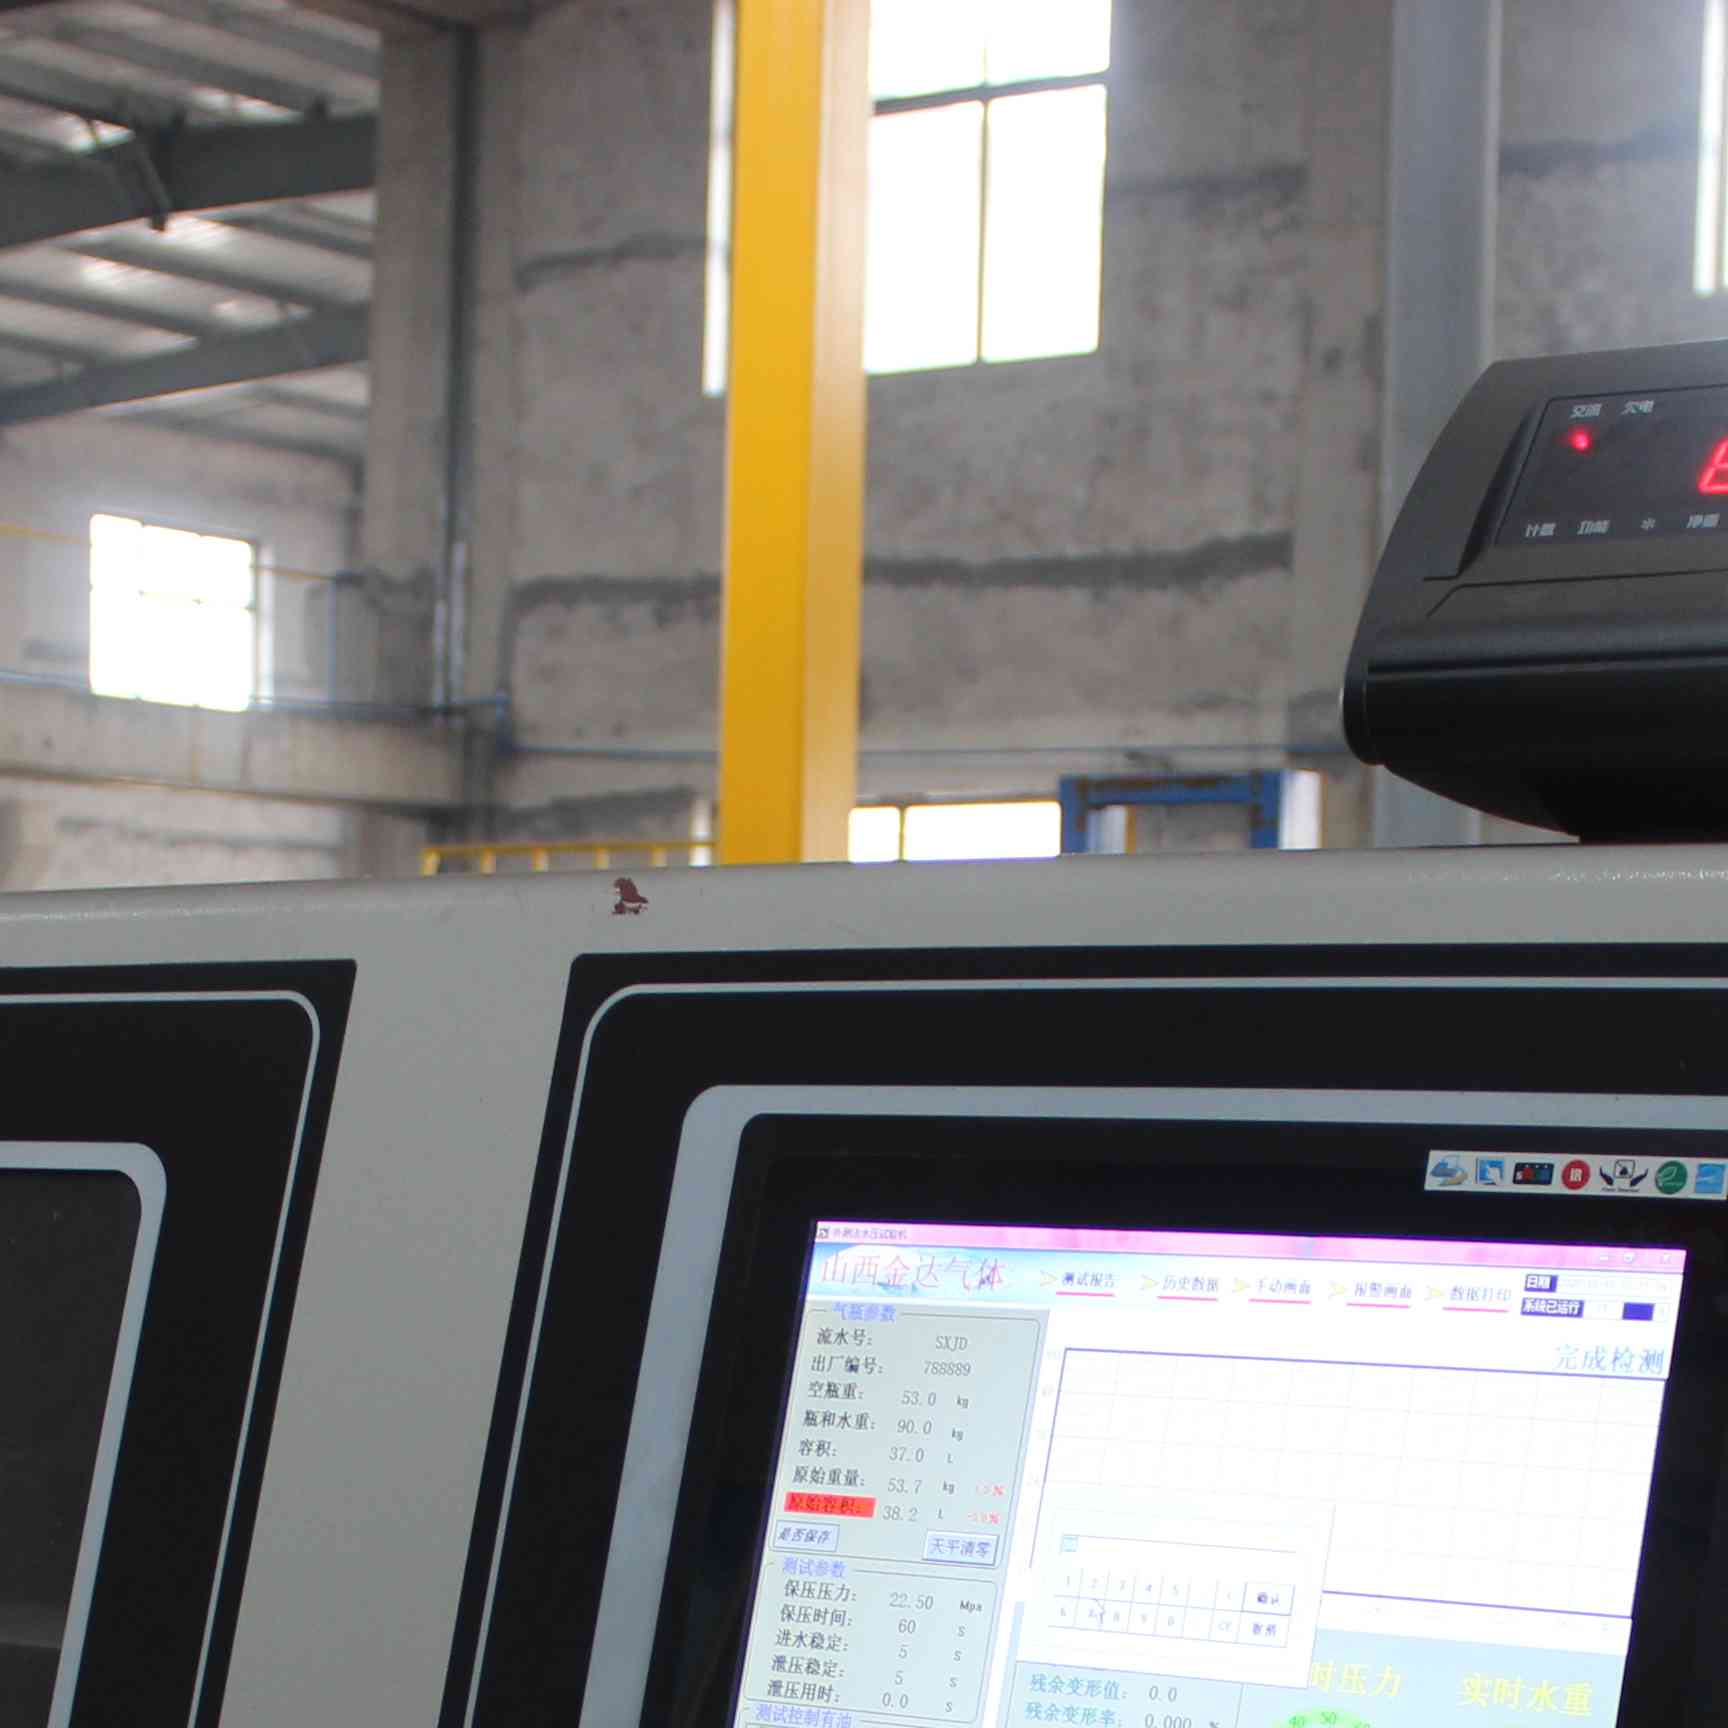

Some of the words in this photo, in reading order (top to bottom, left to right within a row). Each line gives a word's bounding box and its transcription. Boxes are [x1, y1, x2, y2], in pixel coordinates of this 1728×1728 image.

[821, 1253, 1005, 1292] 山西金达气体
[1555, 1344, 1666, 1376] 完成检测
[956, 1395, 969, 1409] kg
[896, 1419, 933, 1436] 90.0
[888, 1446, 925, 1463] 37.0
[887, 1479, 922, 1495] 53.7
[898, 1618, 917, 1635] 60
[898, 1644, 908, 1660] 5
[894, 1670, 904, 1686] 5
[881, 1692, 909, 1709] 0.0
[1148, 1685, 1178, 1703] 0.0
[1459, 1671, 1594, 1718] 实时水重
